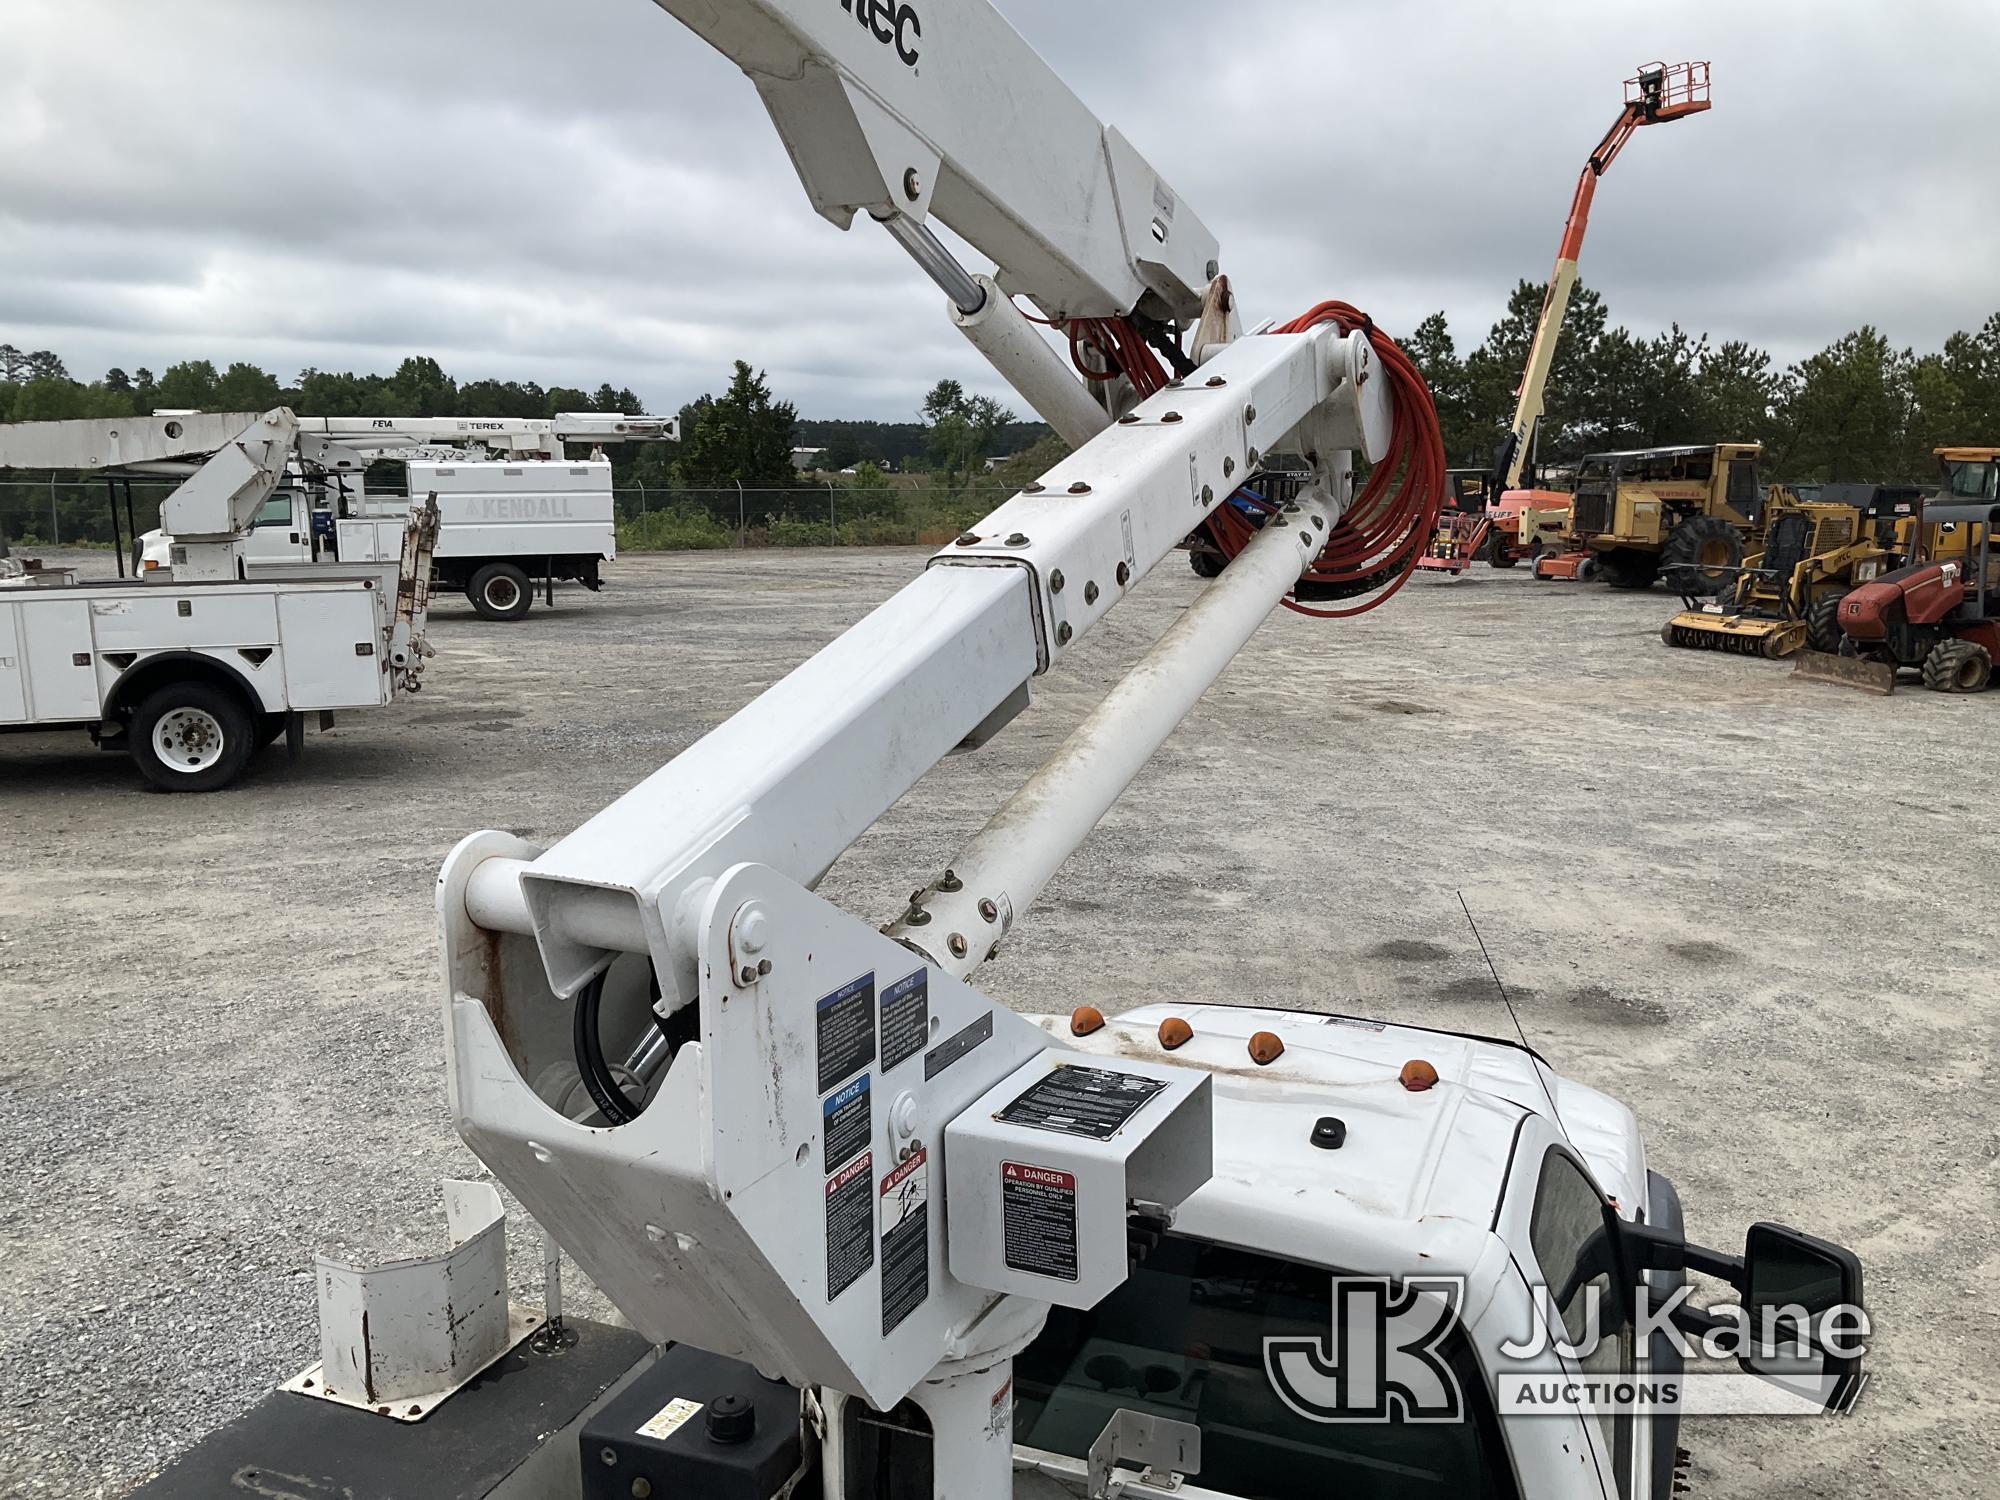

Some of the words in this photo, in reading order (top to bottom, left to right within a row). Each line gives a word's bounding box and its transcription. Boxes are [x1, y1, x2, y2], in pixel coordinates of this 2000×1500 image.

[469, 422, 504, 430] TEREX
[482, 498, 573, 519] KENDALL
[1493, 511, 1513, 519] LIFT
[893, 976, 914, 996] NOTICE
[835, 1081, 860, 1106] NOTICE
[840, 1155, 869, 1184] DANGER
[894, 1154, 921, 1182] DANGER
[1024, 1168, 1064, 1185] DANGER
[1004, 1177, 1036, 1189] OPERATION
[1035, 1182, 1044, 1190] BY
[1044, 1185, 1074, 1196] QUALIFIED
[1014, 1186, 1048, 1198] PERSONNEL
[1048, 1192, 1063, 1200] ONLY
